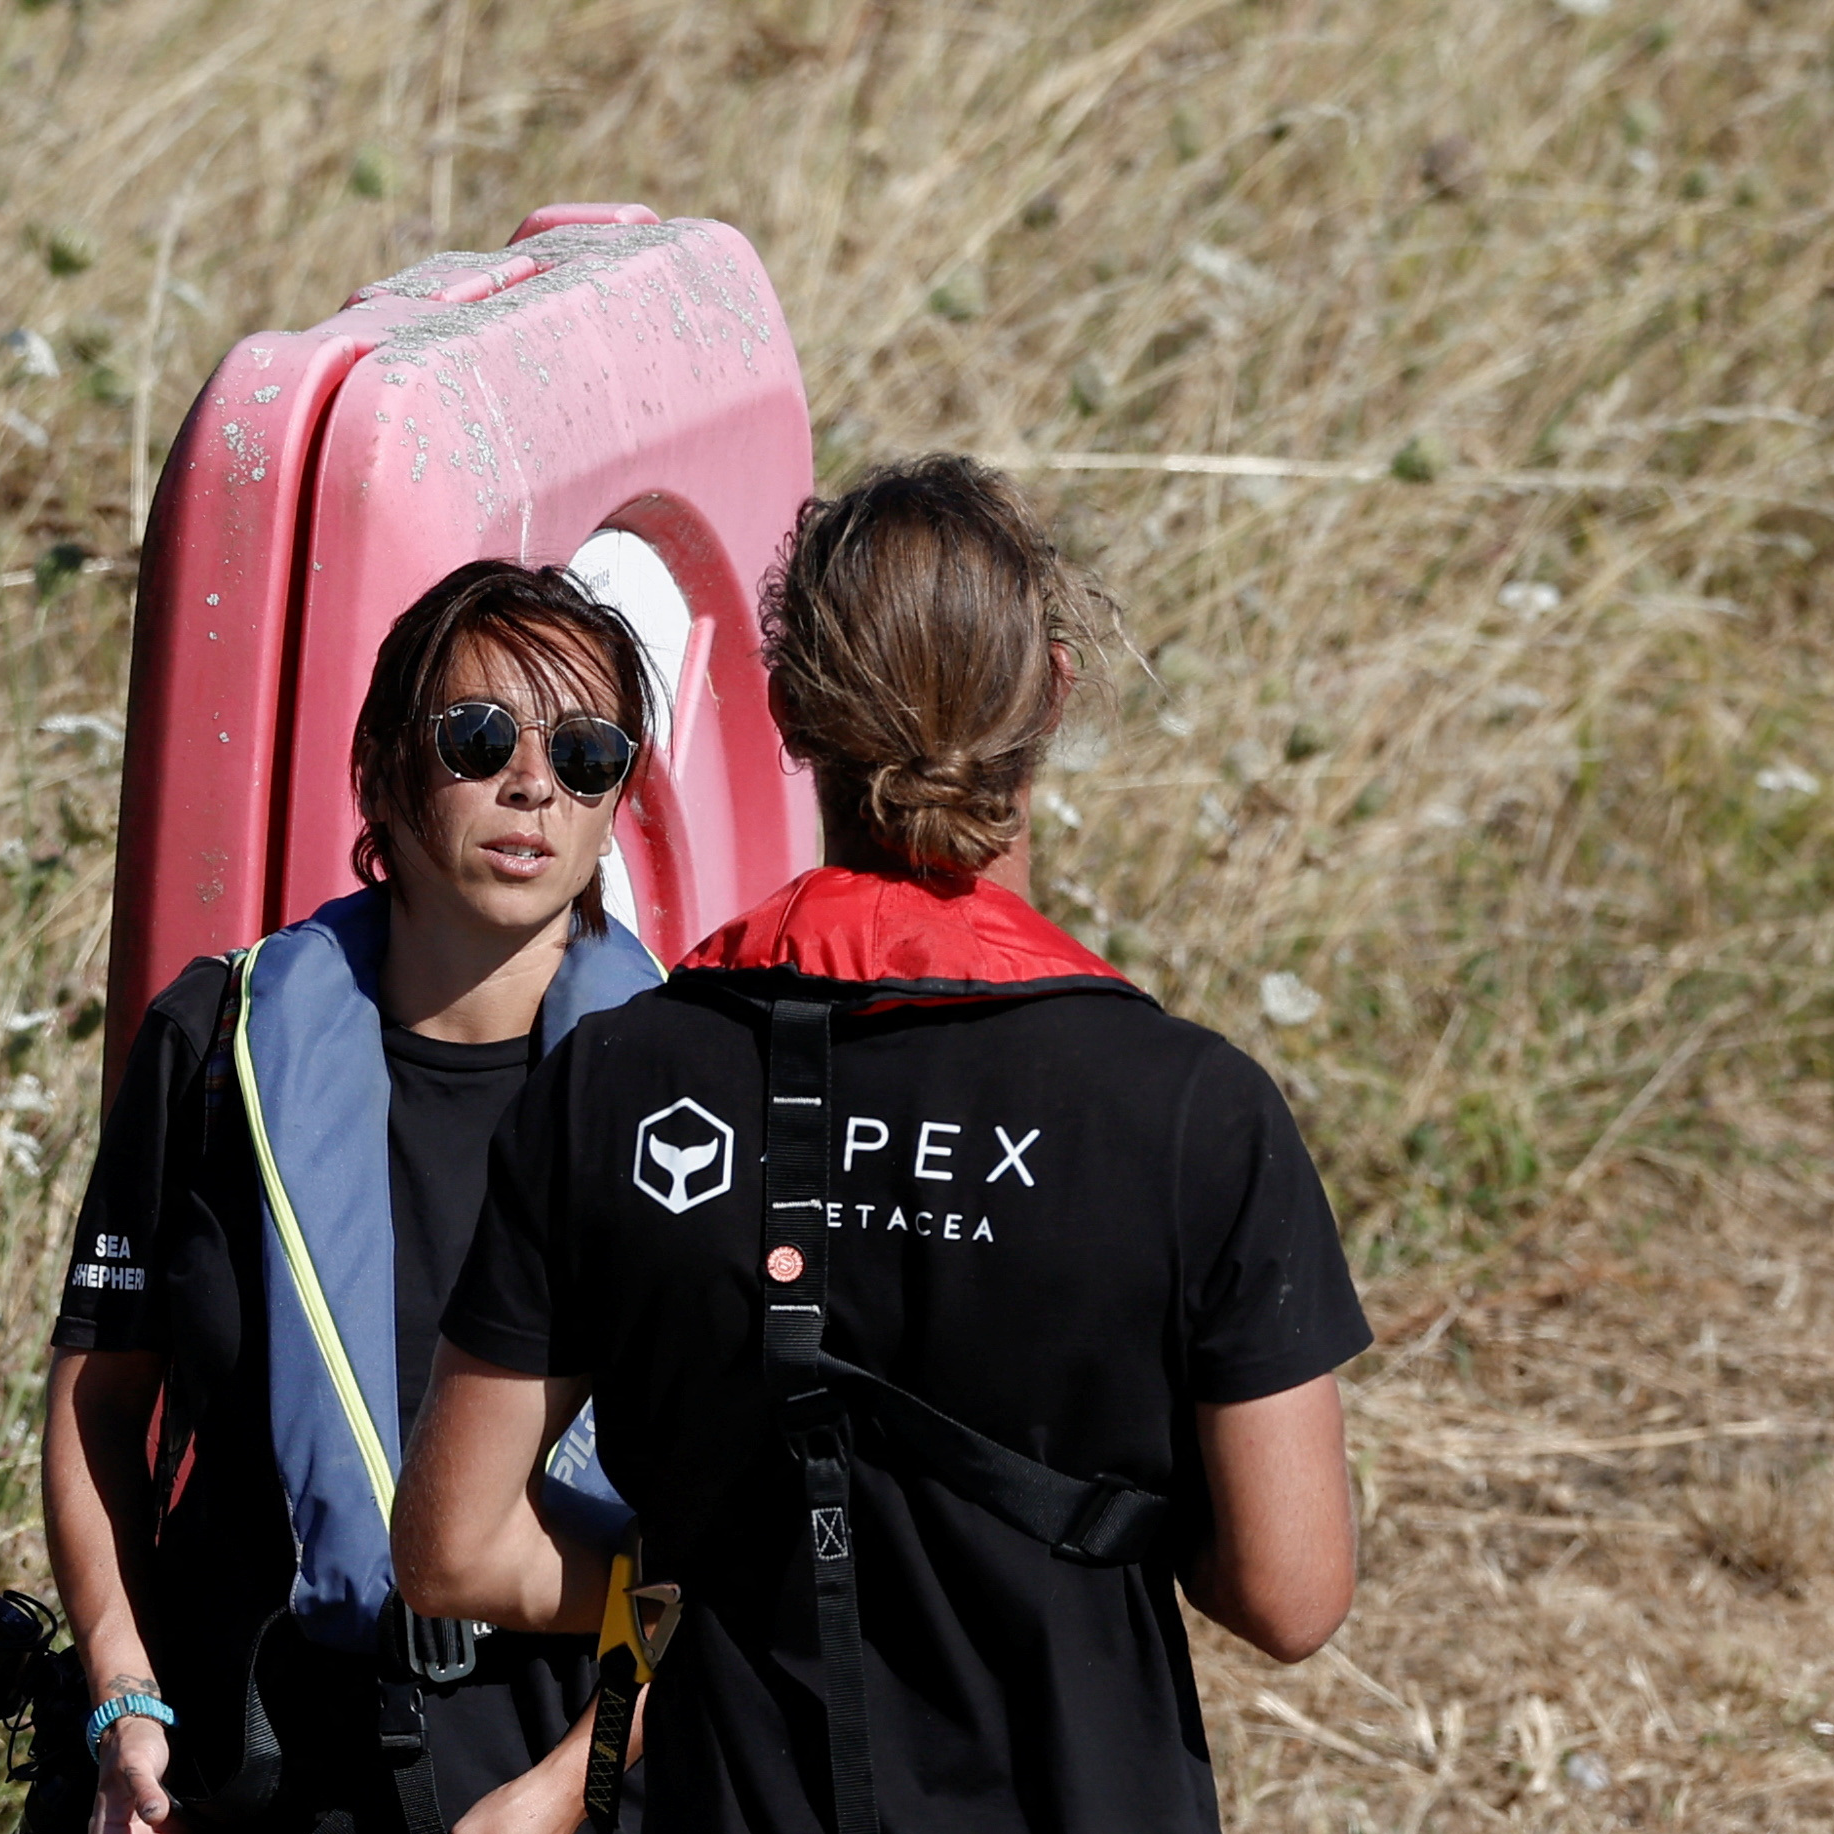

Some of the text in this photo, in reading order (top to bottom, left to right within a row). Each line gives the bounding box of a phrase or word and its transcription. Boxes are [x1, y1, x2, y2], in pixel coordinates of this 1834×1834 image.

[761, 1116, 1041, 1188] PEX
[826, 1203, 994, 1243] ETACEA
[94, 1233, 131, 1259] SEA
